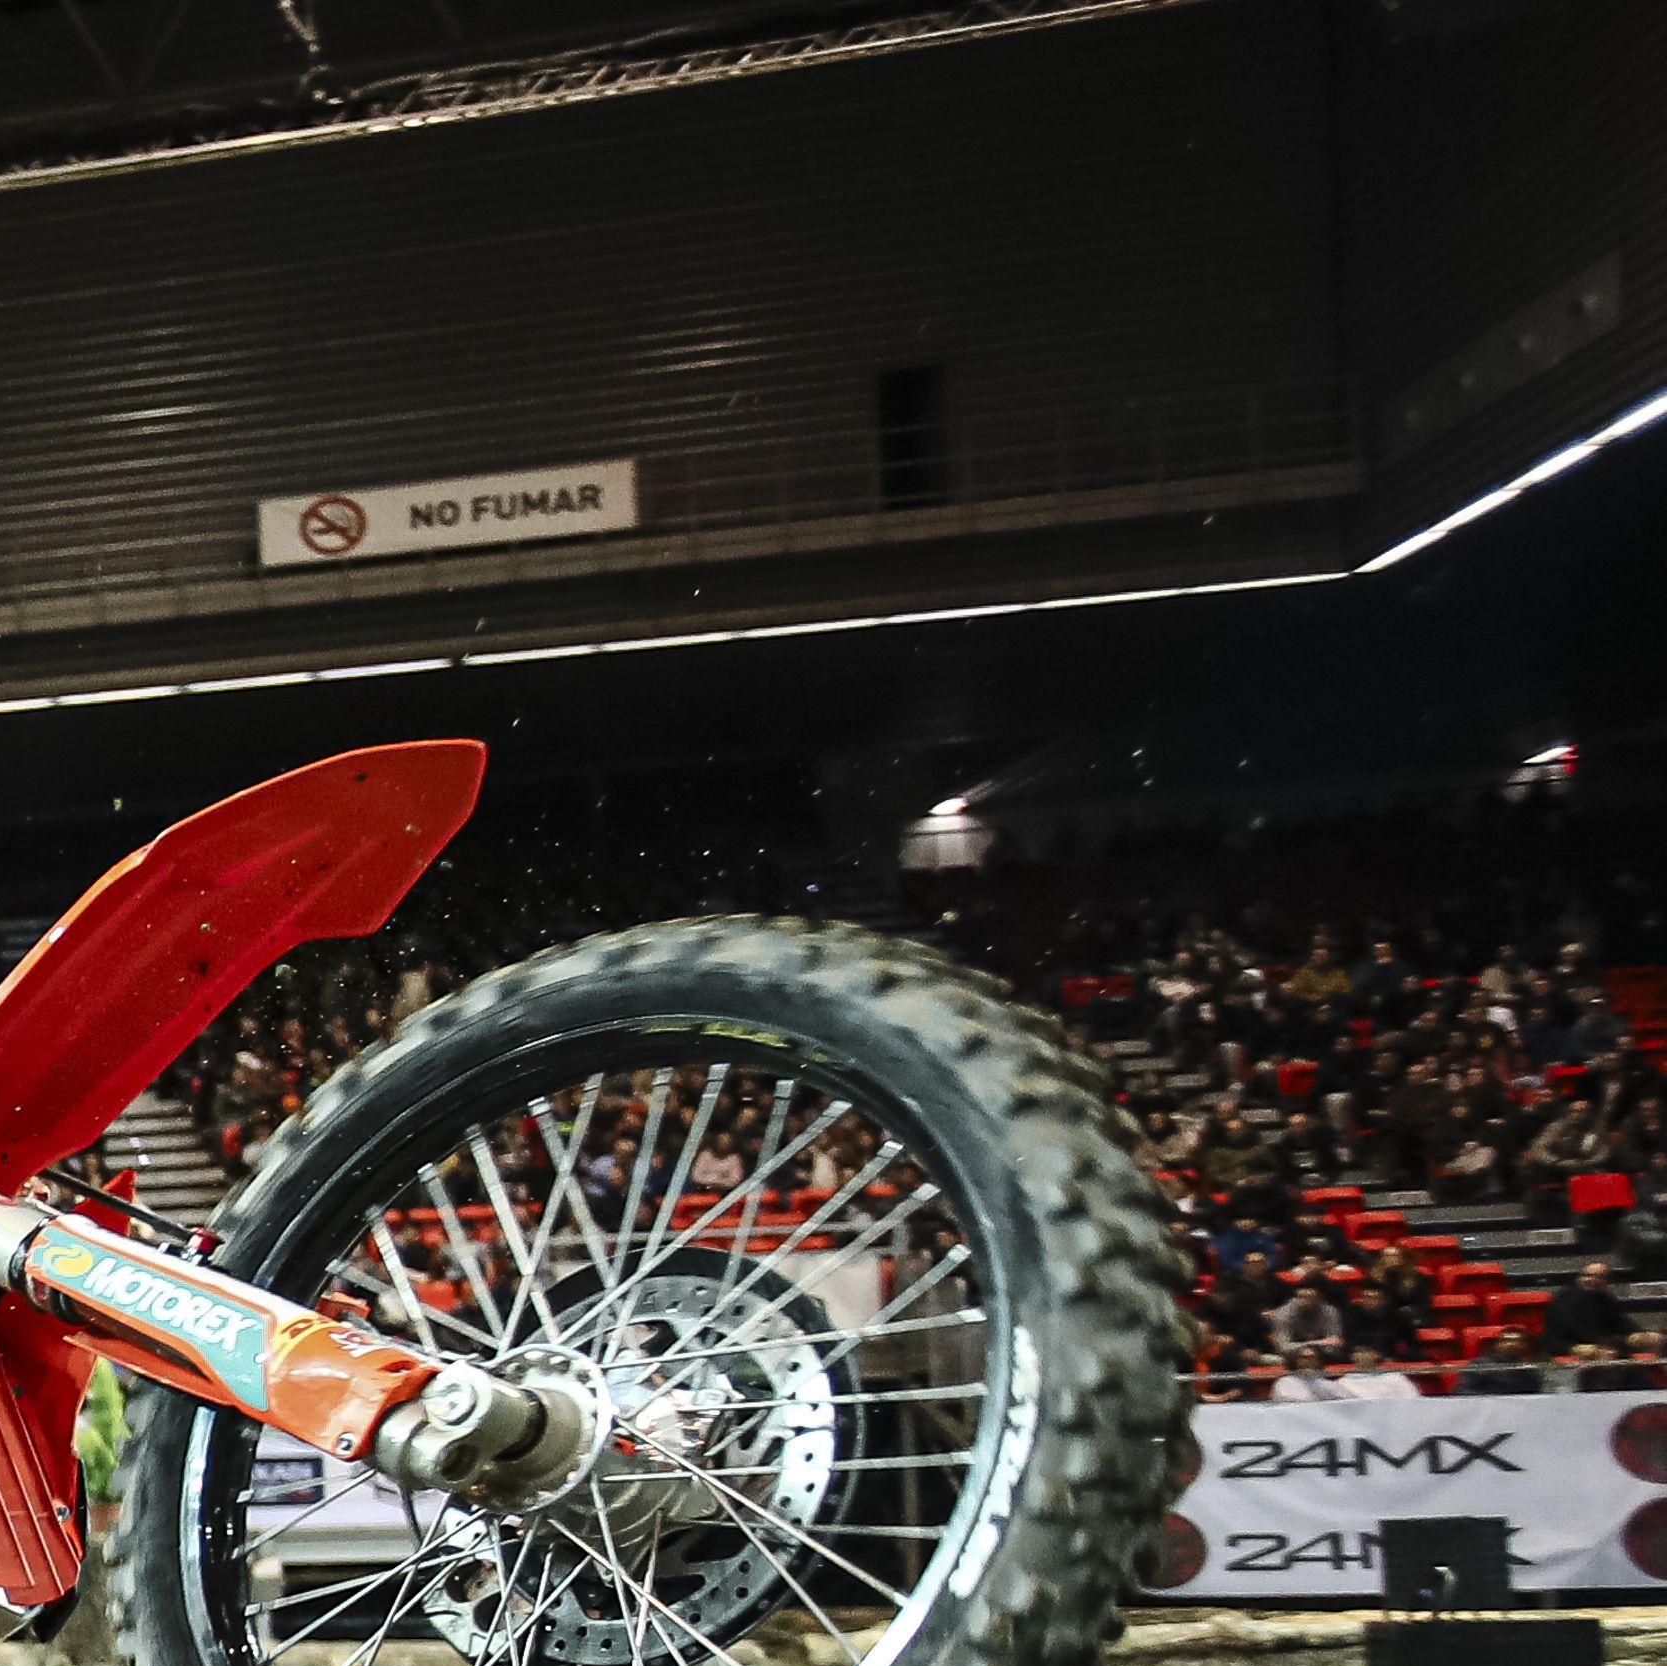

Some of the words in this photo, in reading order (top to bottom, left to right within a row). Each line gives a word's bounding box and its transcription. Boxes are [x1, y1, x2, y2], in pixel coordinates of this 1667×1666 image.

[409, 502, 460, 530] NO
[472, 483, 605, 525] FUMAR
[82, 1257, 259, 1352] MOTOREX
[1220, 1432, 1524, 1479] 24MX
